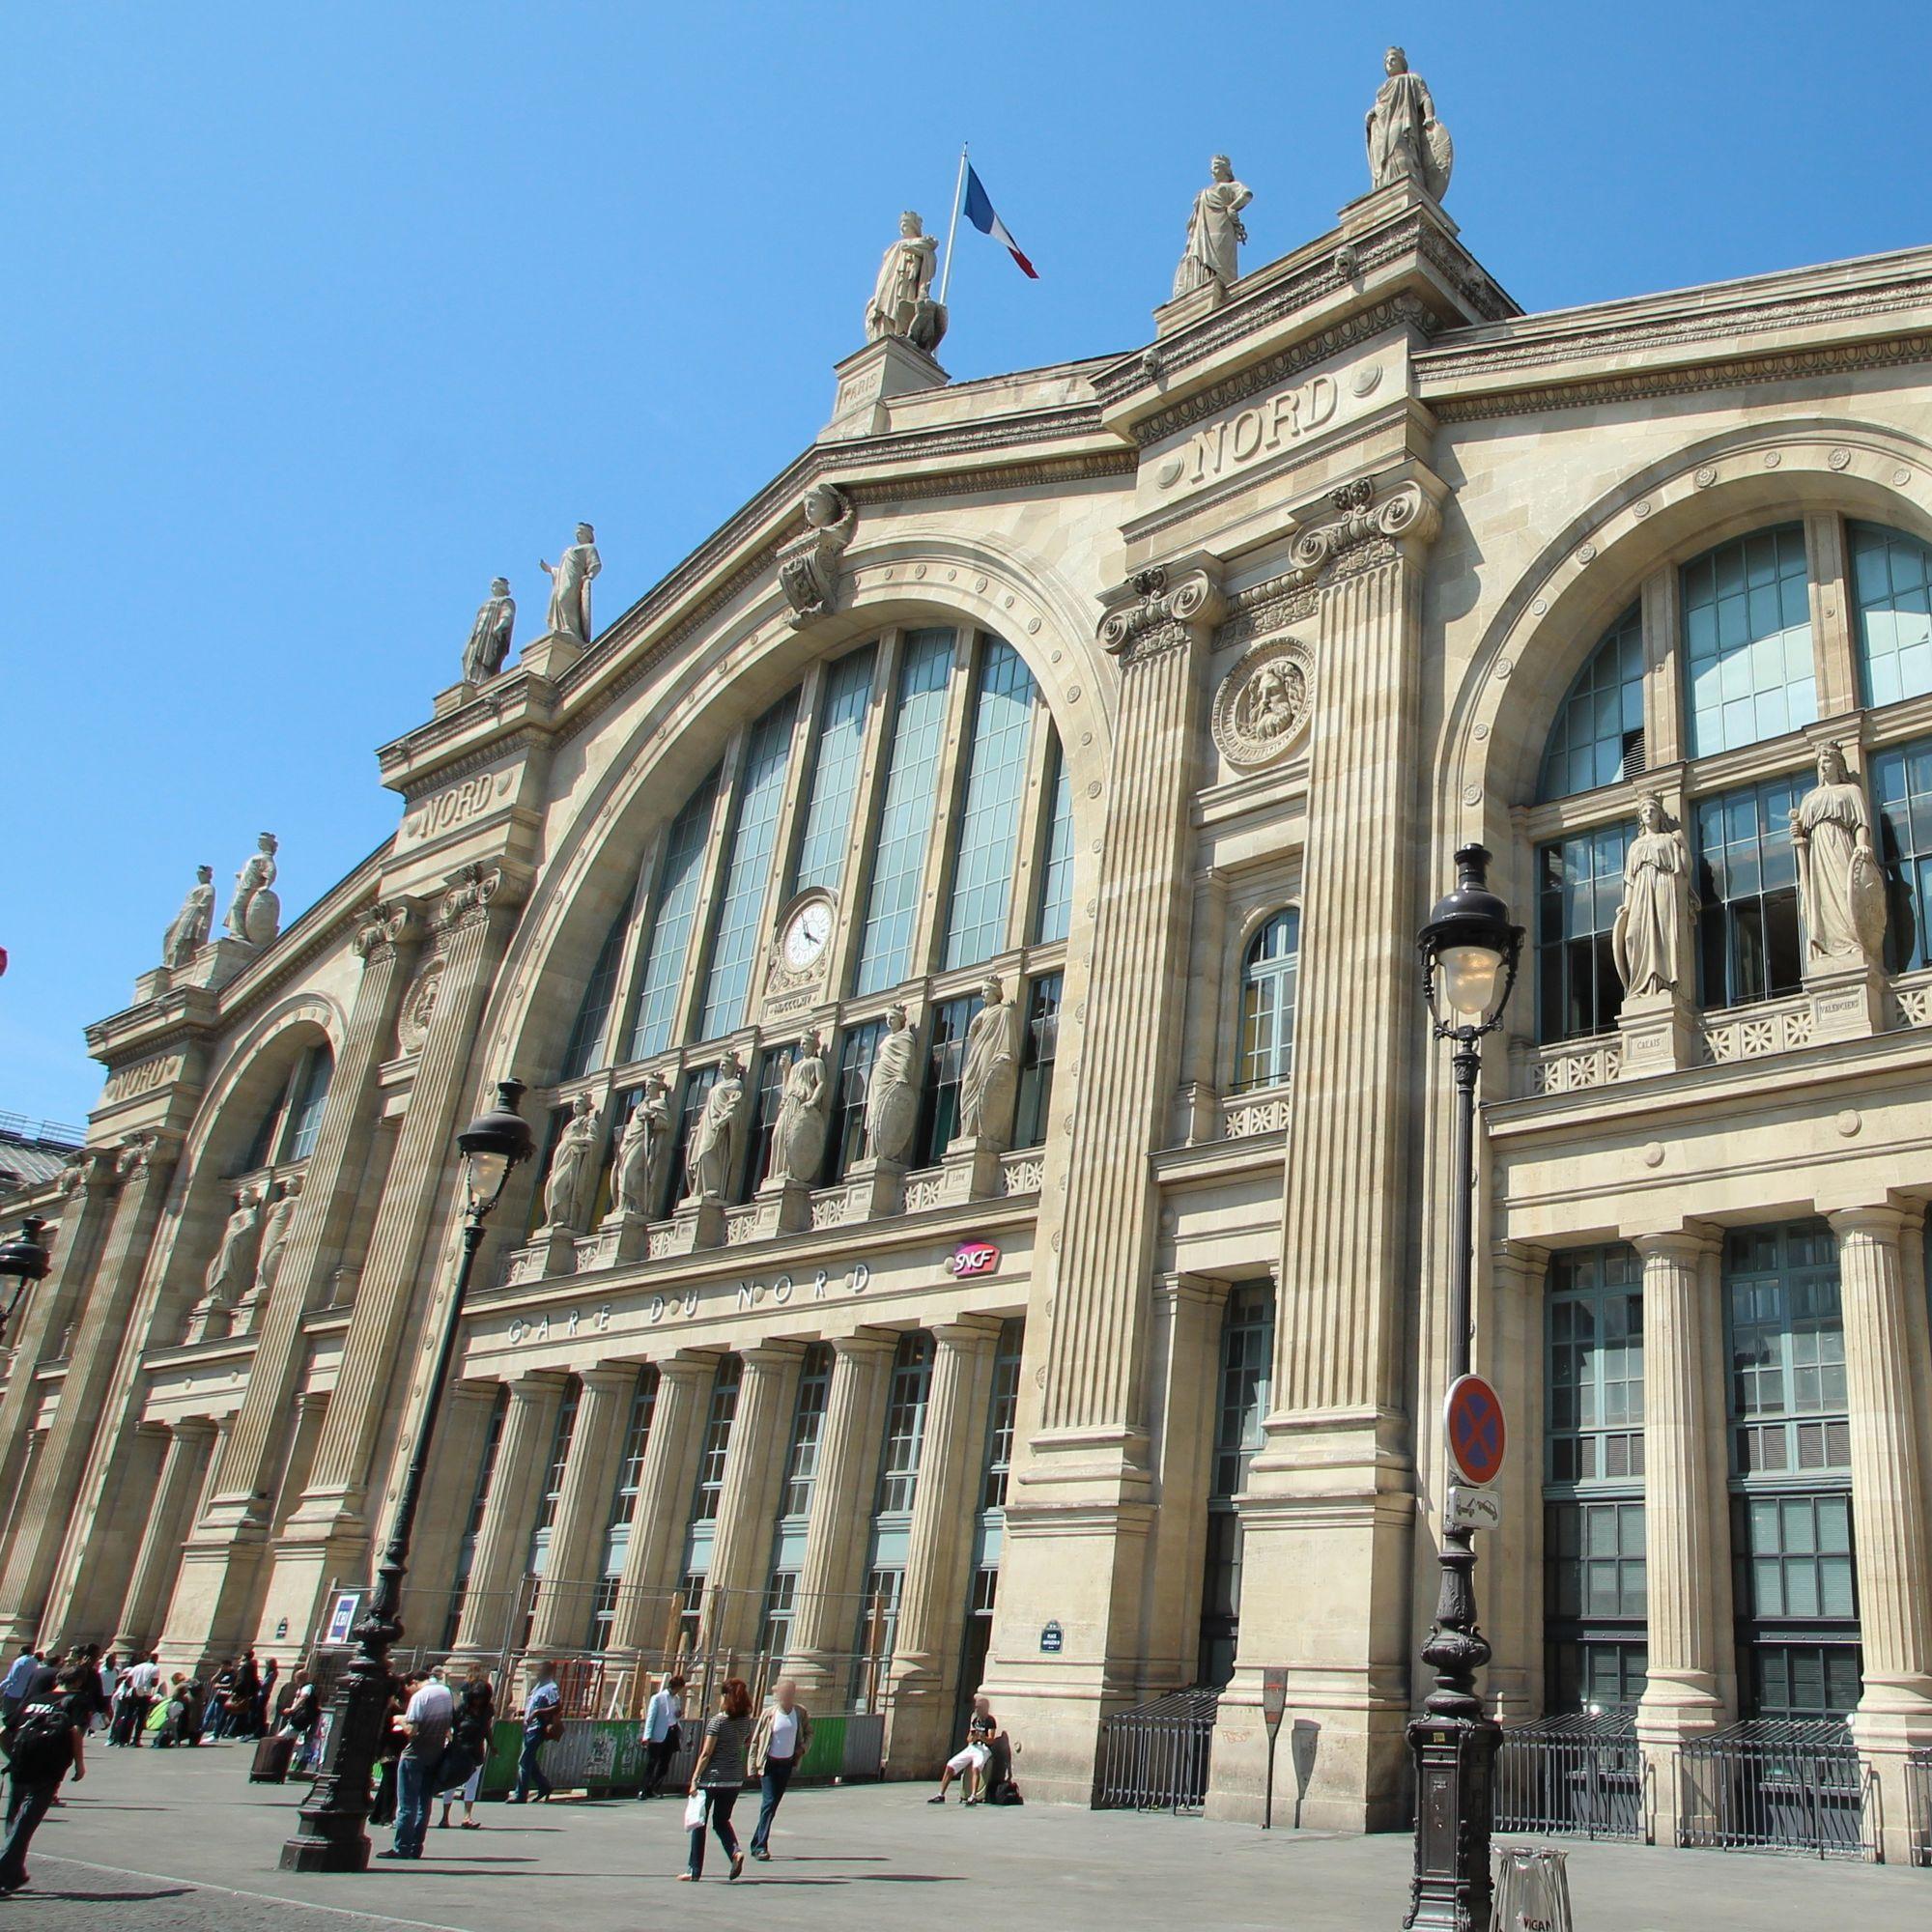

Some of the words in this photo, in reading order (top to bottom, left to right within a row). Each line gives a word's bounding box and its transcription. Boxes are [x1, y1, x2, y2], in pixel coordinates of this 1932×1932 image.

[843, 373, 878, 402] PARIS
[1189, 373, 1339, 484] NORD
[419, 773, 494, 838] NORD
[1636, 1038, 1661, 1050] CALAIS
[952, 1249, 995, 1272] SNCF
[508, 1304, 611, 1343] GARE
[649, 1291, 697, 1322] DU
[737, 1264, 868, 1311] NORD
